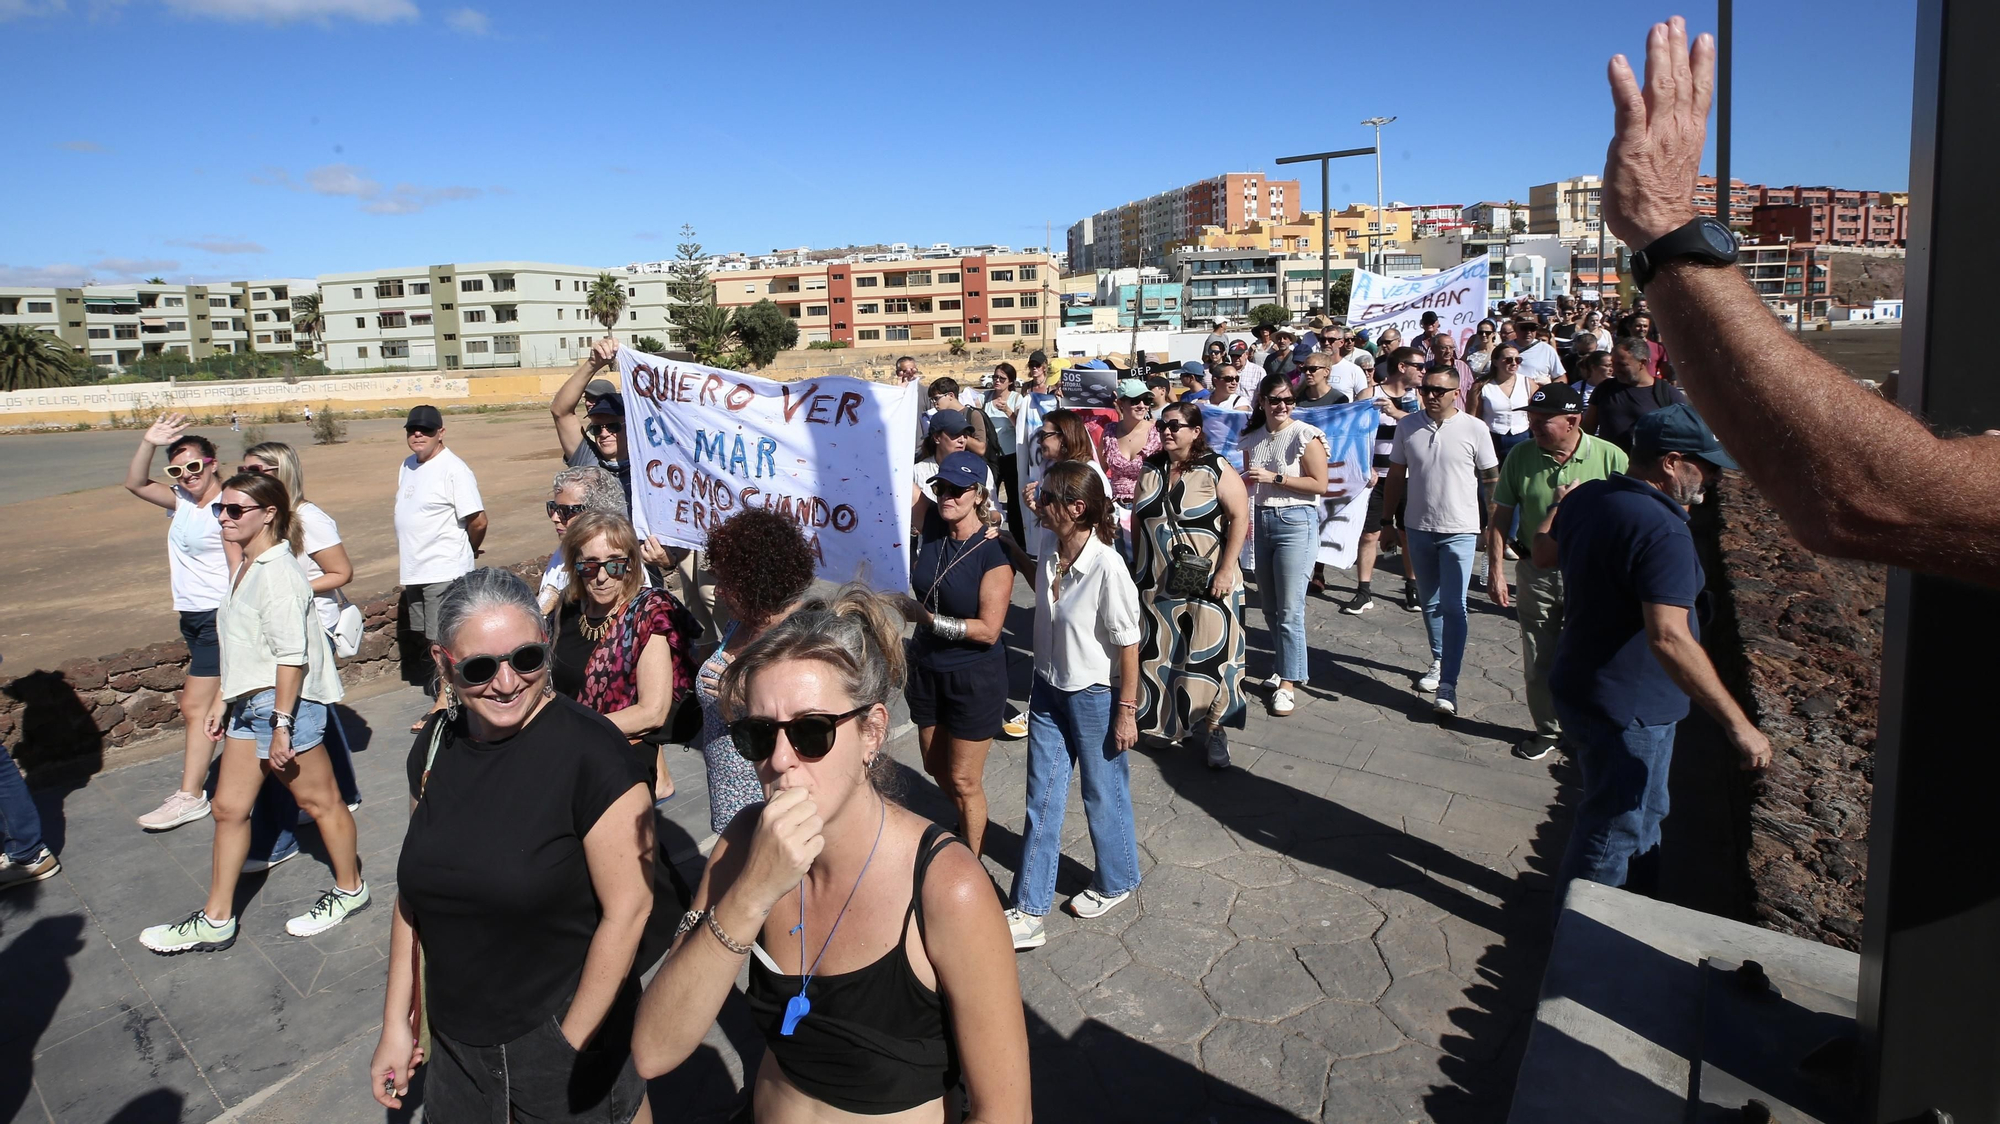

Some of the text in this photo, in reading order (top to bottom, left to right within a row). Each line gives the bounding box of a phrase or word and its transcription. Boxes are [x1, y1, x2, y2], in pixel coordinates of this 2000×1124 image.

[1352, 273, 1372, 300] A
[1381, 282, 1423, 299] VER
[1453, 311, 1476, 325] en
[1062, 372, 1081, 382] SOS
[26, 397, 34, 406] Y
[84, 394, 107, 404] POR
[204, 387, 250, 398] PARQUE
[302, 383, 316, 393] EN
[632, 364, 864, 426] QUIERO VER
[644, 415, 777, 478] EL MAR
[646, 459, 734, 511] COMO
